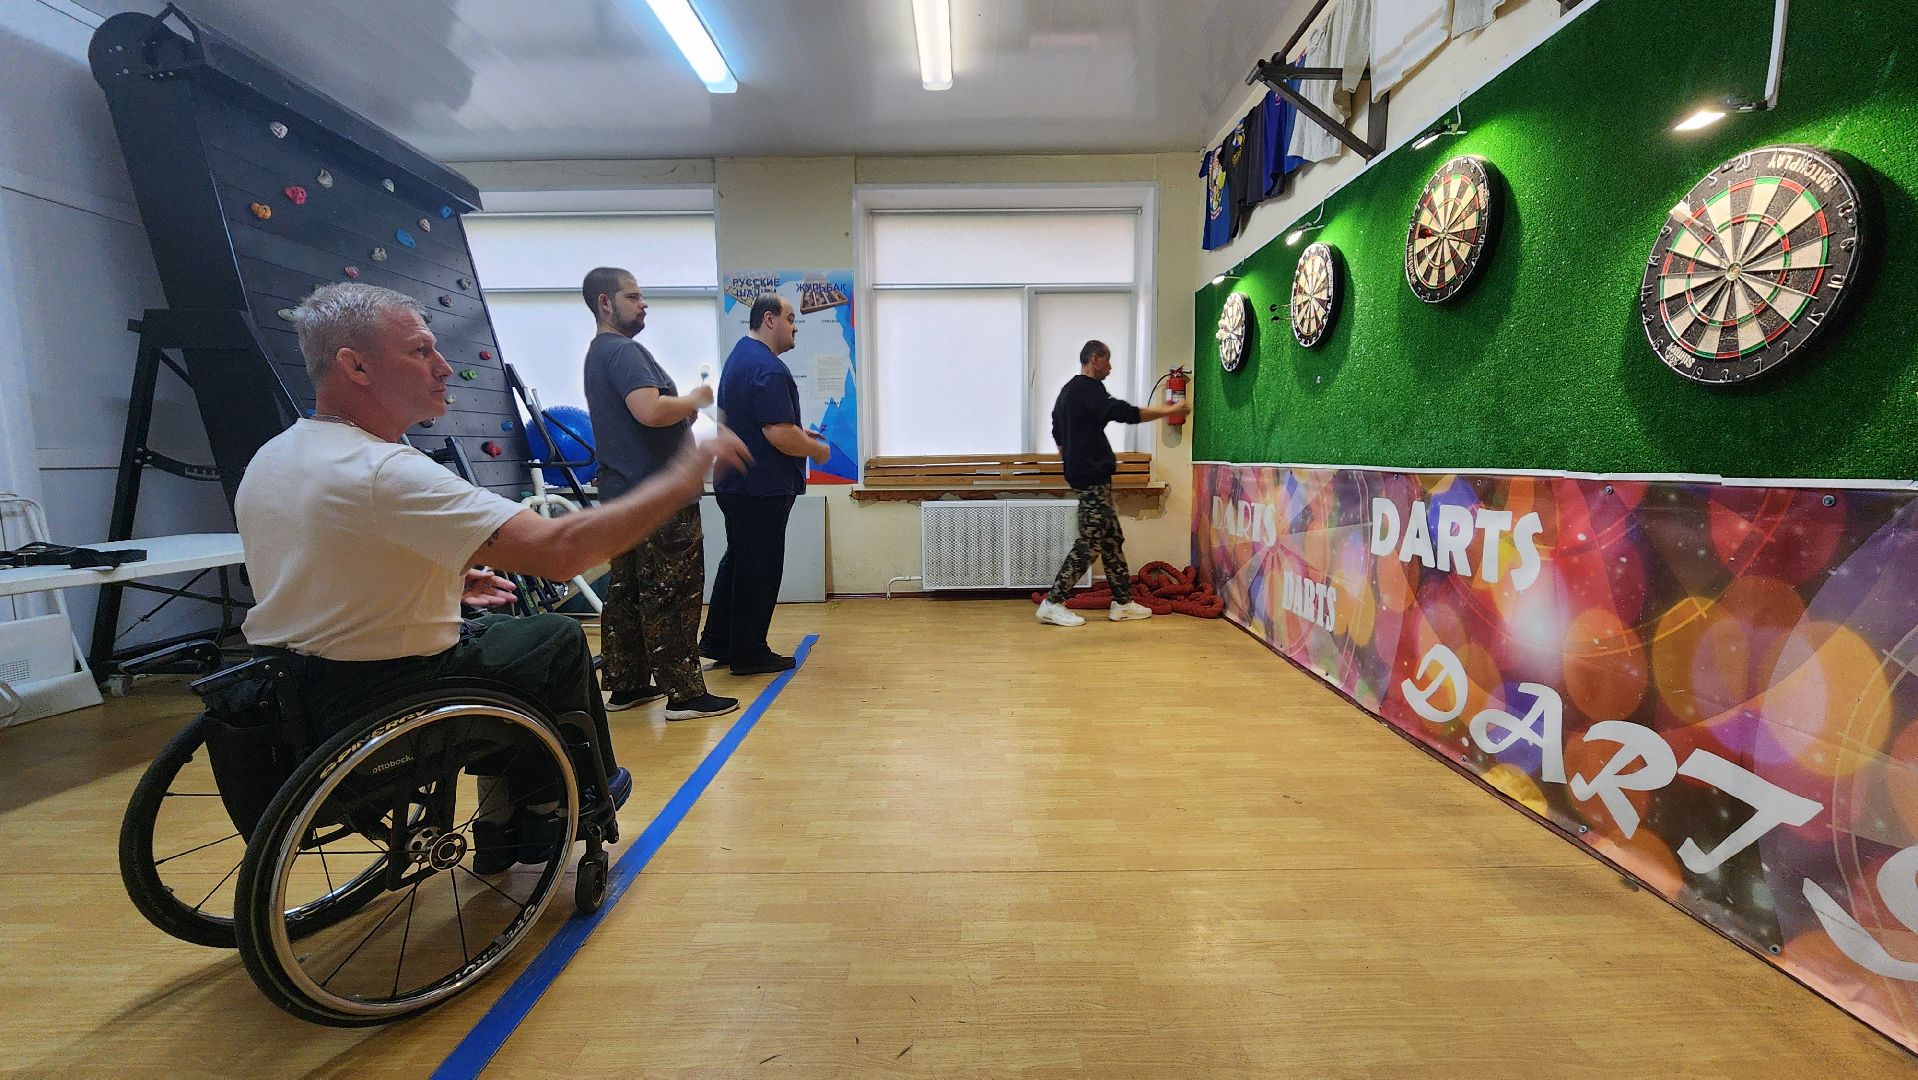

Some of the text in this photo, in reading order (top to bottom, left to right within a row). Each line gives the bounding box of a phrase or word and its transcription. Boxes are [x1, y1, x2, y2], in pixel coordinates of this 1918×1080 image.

[1735, 154, 1752, 173] 20
[1767, 152, 1838, 193] MATCHPLAY
[732, 277, 781, 289] РУССКИЕ
[1826, 273, 1847, 290] 10
[1212, 496, 1277, 547] DARTS
[1370, 497, 1543, 591] DARTS
[1281, 570, 1337, 632] DARTS
